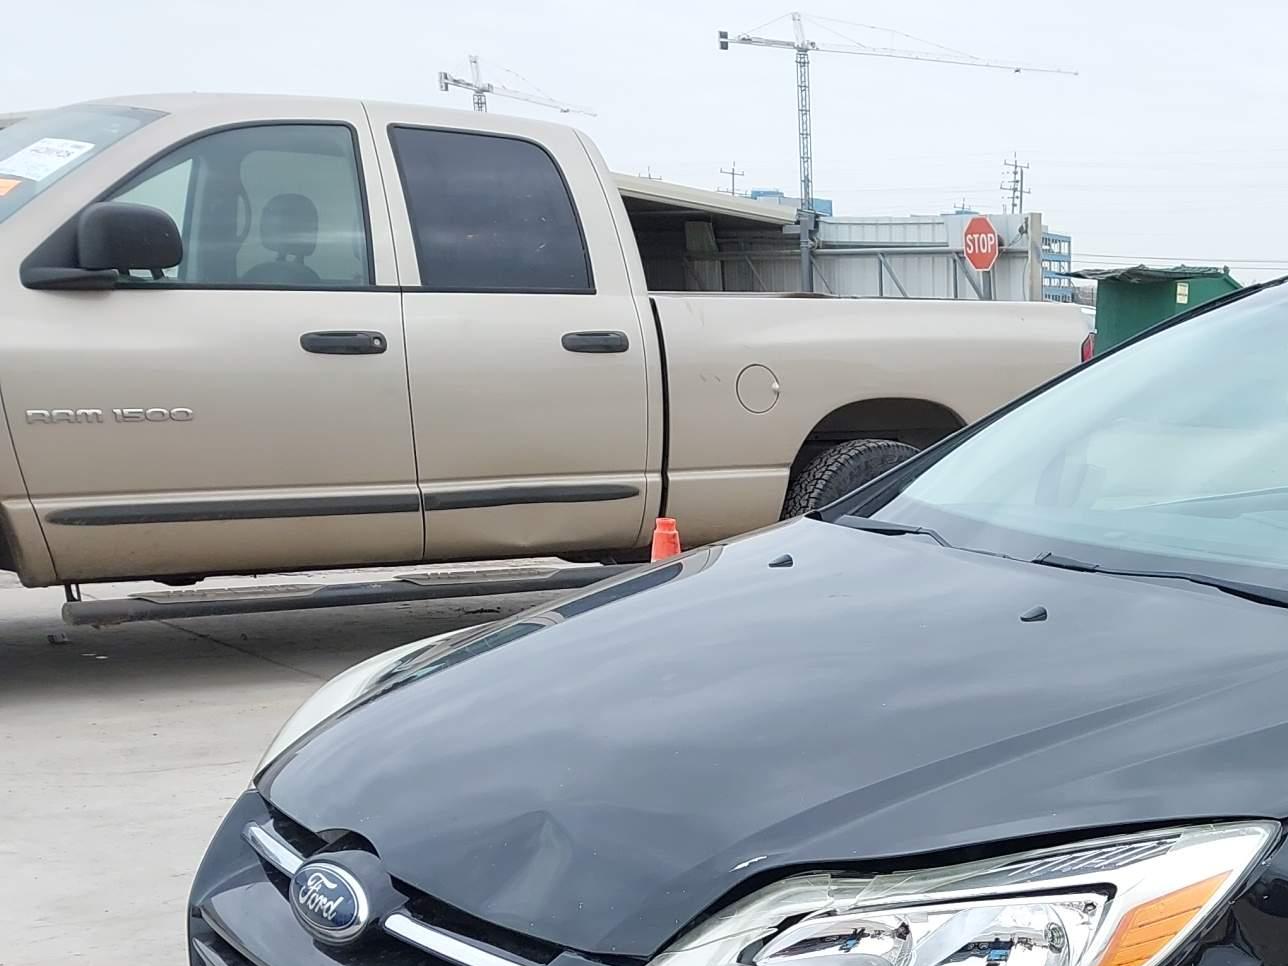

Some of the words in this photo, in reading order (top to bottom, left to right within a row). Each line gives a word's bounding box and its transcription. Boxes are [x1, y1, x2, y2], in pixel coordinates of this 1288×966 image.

[966, 233, 995, 254] STOP
[25, 408, 104, 425] RAM
[112, 407, 193, 424] 1500
[298, 872, 345, 920] Ford
